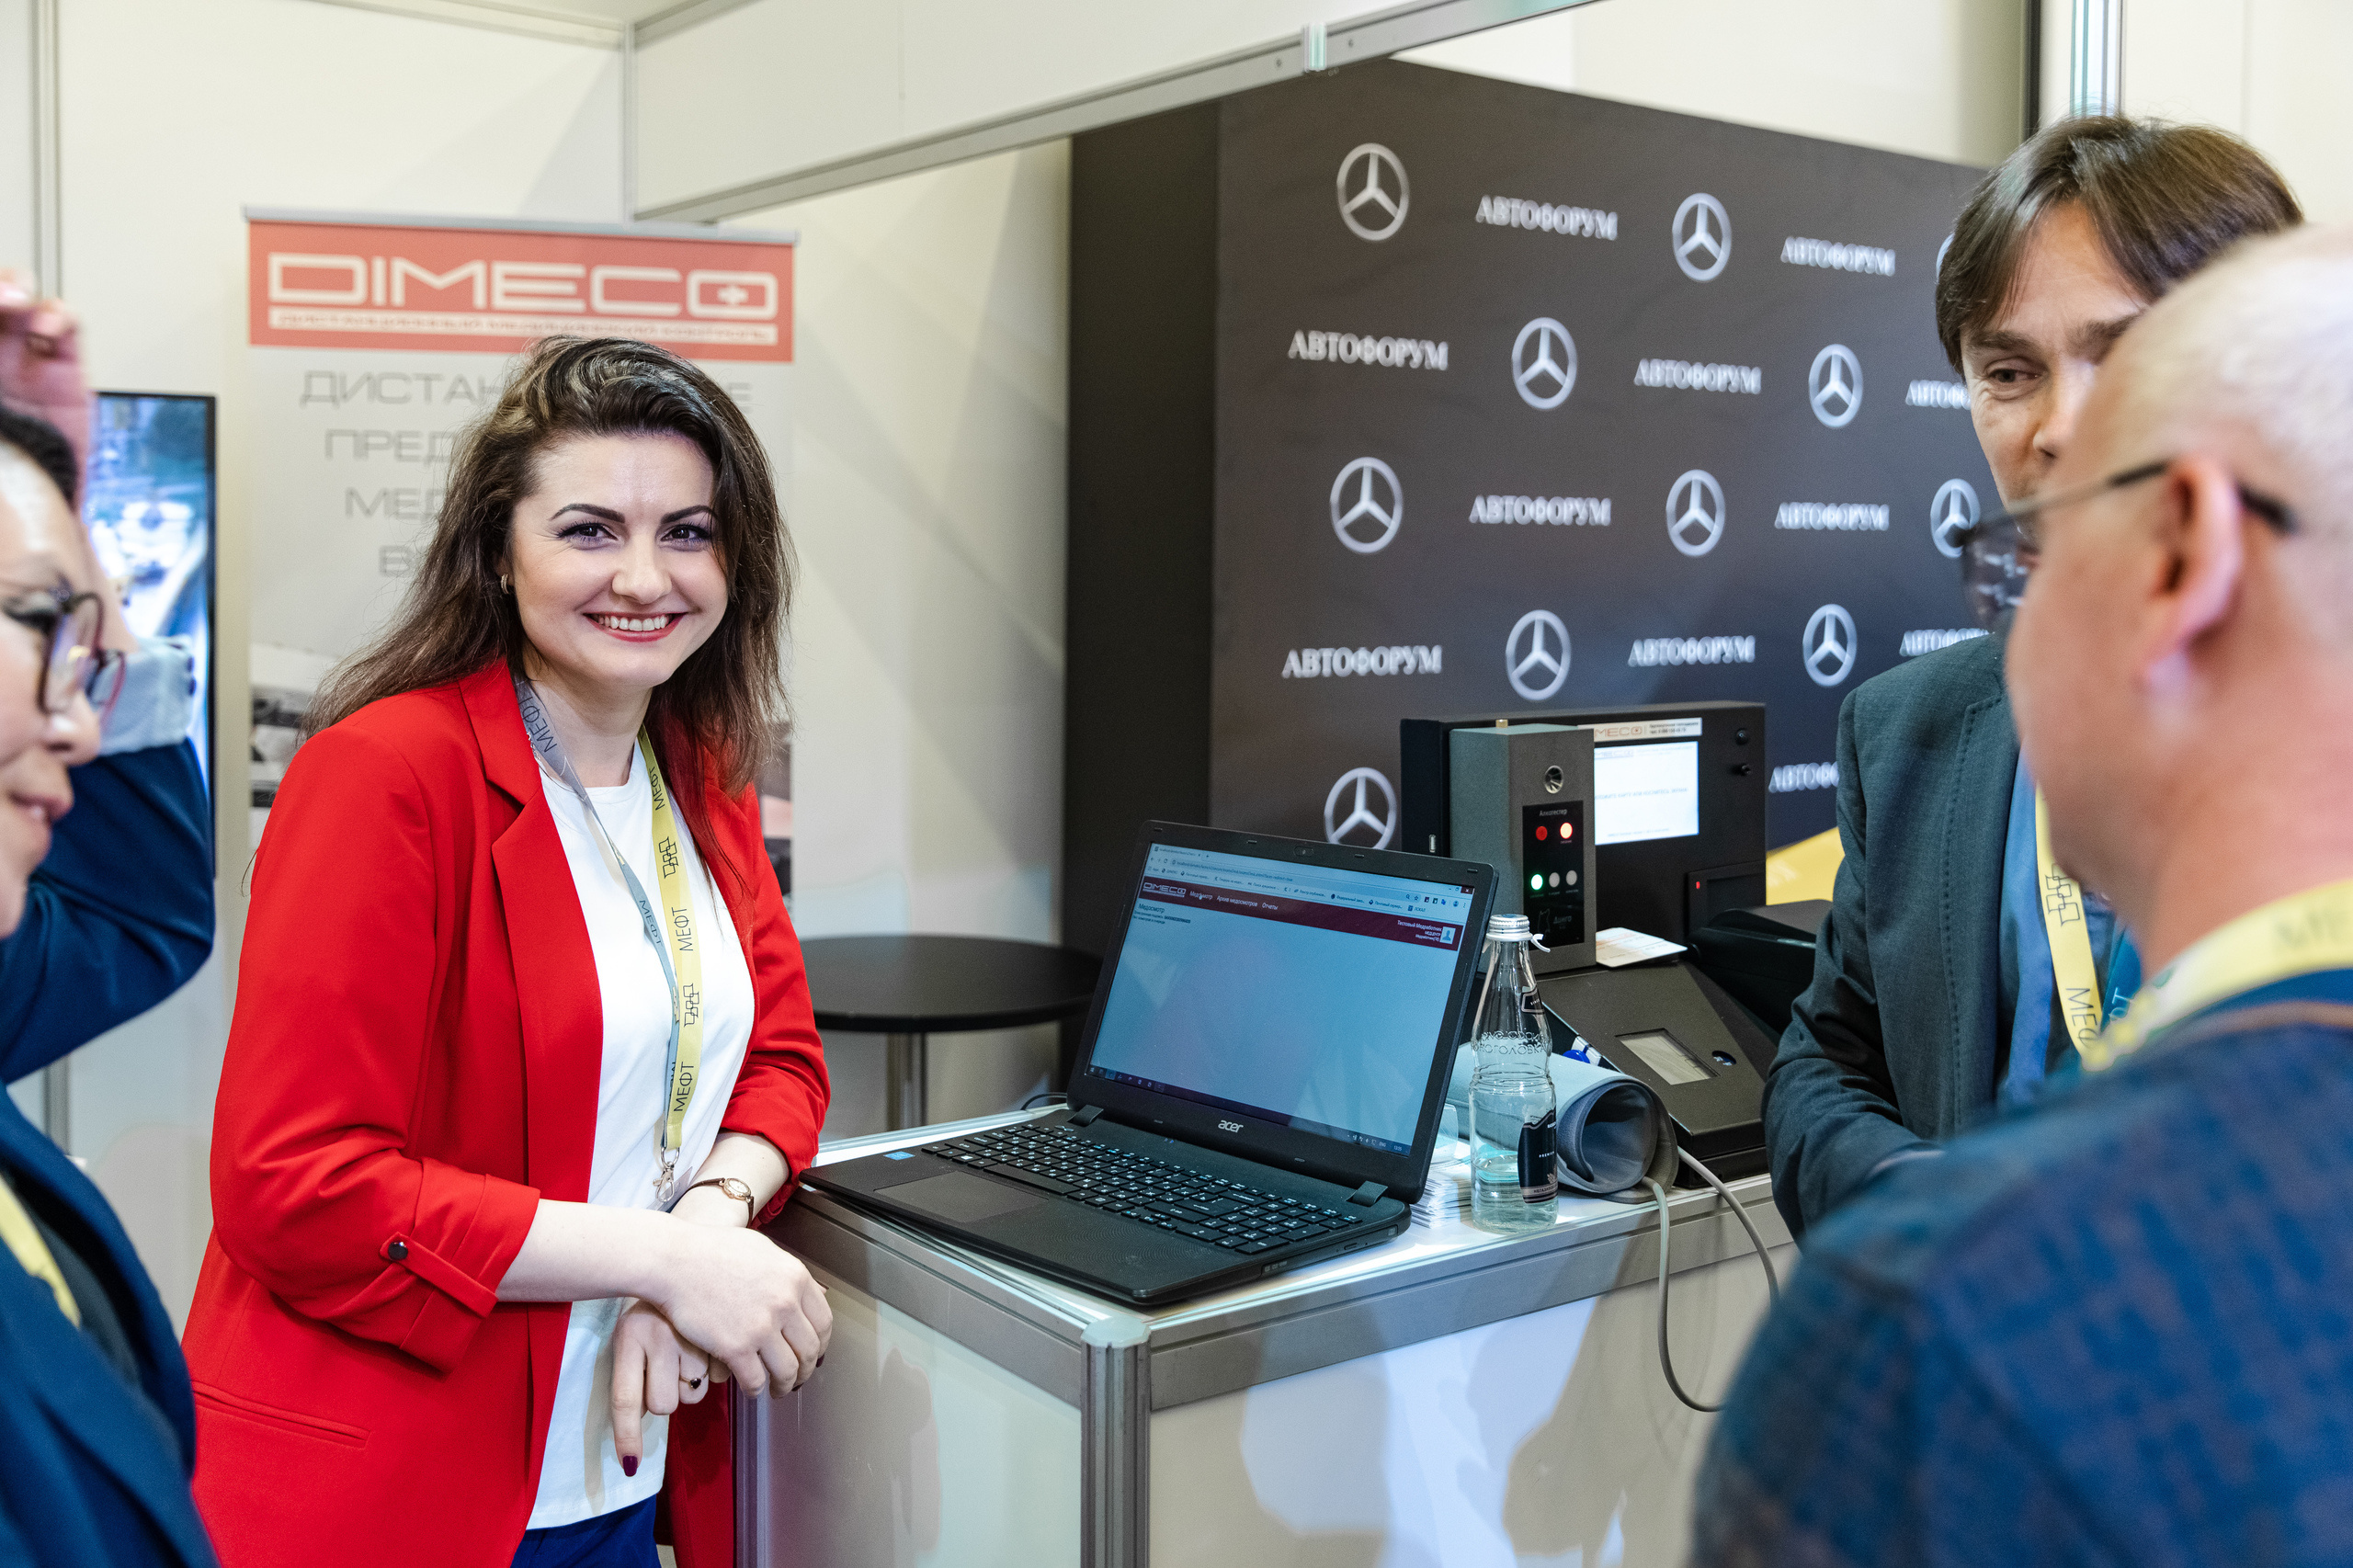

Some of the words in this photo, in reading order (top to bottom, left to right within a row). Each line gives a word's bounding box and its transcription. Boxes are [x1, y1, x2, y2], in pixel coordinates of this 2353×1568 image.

[1475, 195, 1619, 241] АВТОФОРУМ
[1780, 236, 1896, 276] АВТОФОРУМ
[267, 253, 779, 320] DIMECO
[1288, 329, 1449, 370] АВТОФОРУМ
[1633, 358, 1762, 394] АВТОФОРУМ
[1469, 494, 1611, 526] АВТОФОРУМ
[1774, 501, 1890, 531] АВТОФОРУМ
[1281, 644, 1442, 678] АВТОФОРУМ
[1628, 635, 1756, 667] АВТОФОРУМ
[1594, 725, 1643, 738] MECO
[647, 766, 665, 811] МЕФТ
[1539, 808, 1568, 817] Алкотестер
[1142, 881, 1187, 895] DIMECO
[638, 899, 663, 947] МЕФТ
[671, 906, 694, 951] МЕФТ
[2065, 987, 2102, 1049] МЕФ
[673, 1061, 695, 1112] МЕФТ
[1218, 1119, 1245, 1133] acer
